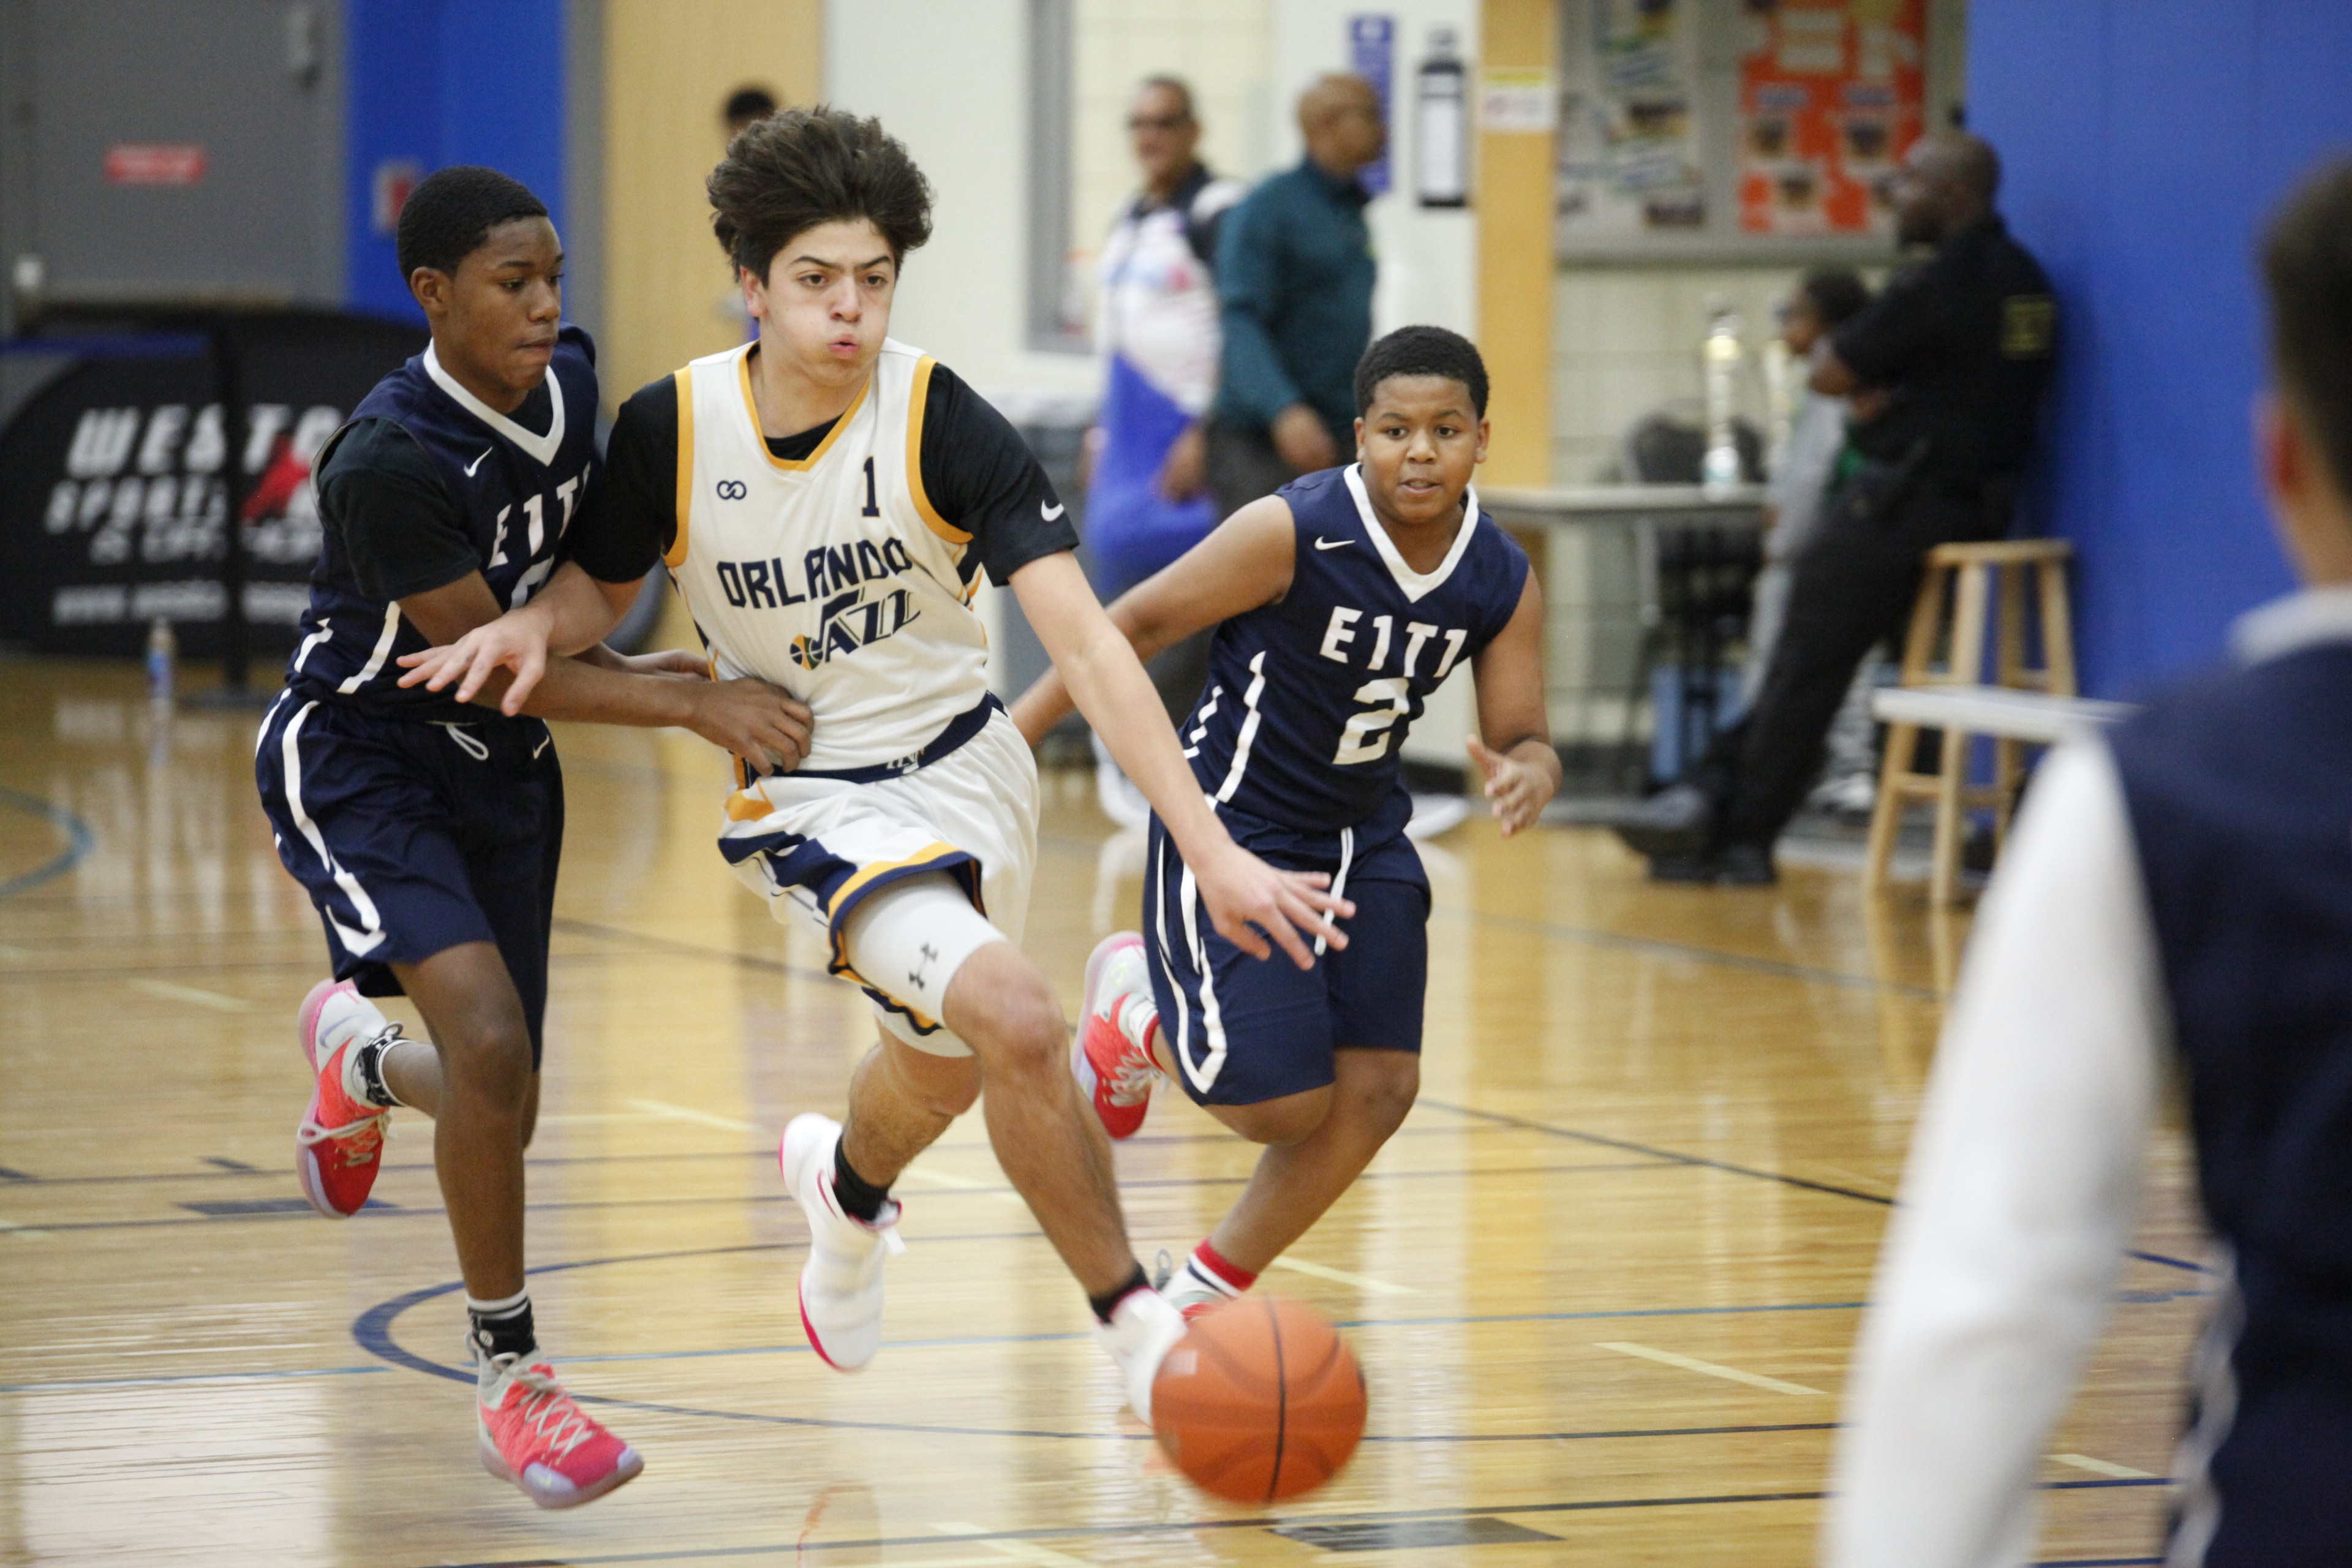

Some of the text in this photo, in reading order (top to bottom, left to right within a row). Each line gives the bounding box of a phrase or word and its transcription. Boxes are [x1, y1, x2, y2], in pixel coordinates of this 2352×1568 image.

[861, 456, 880, 517] 1
[716, 537, 913, 609] ORLANDO
[790, 586, 921, 670] JAZZ
[1320, 605, 1468, 678] E1T1
[1332, 677, 1410, 765] 2
